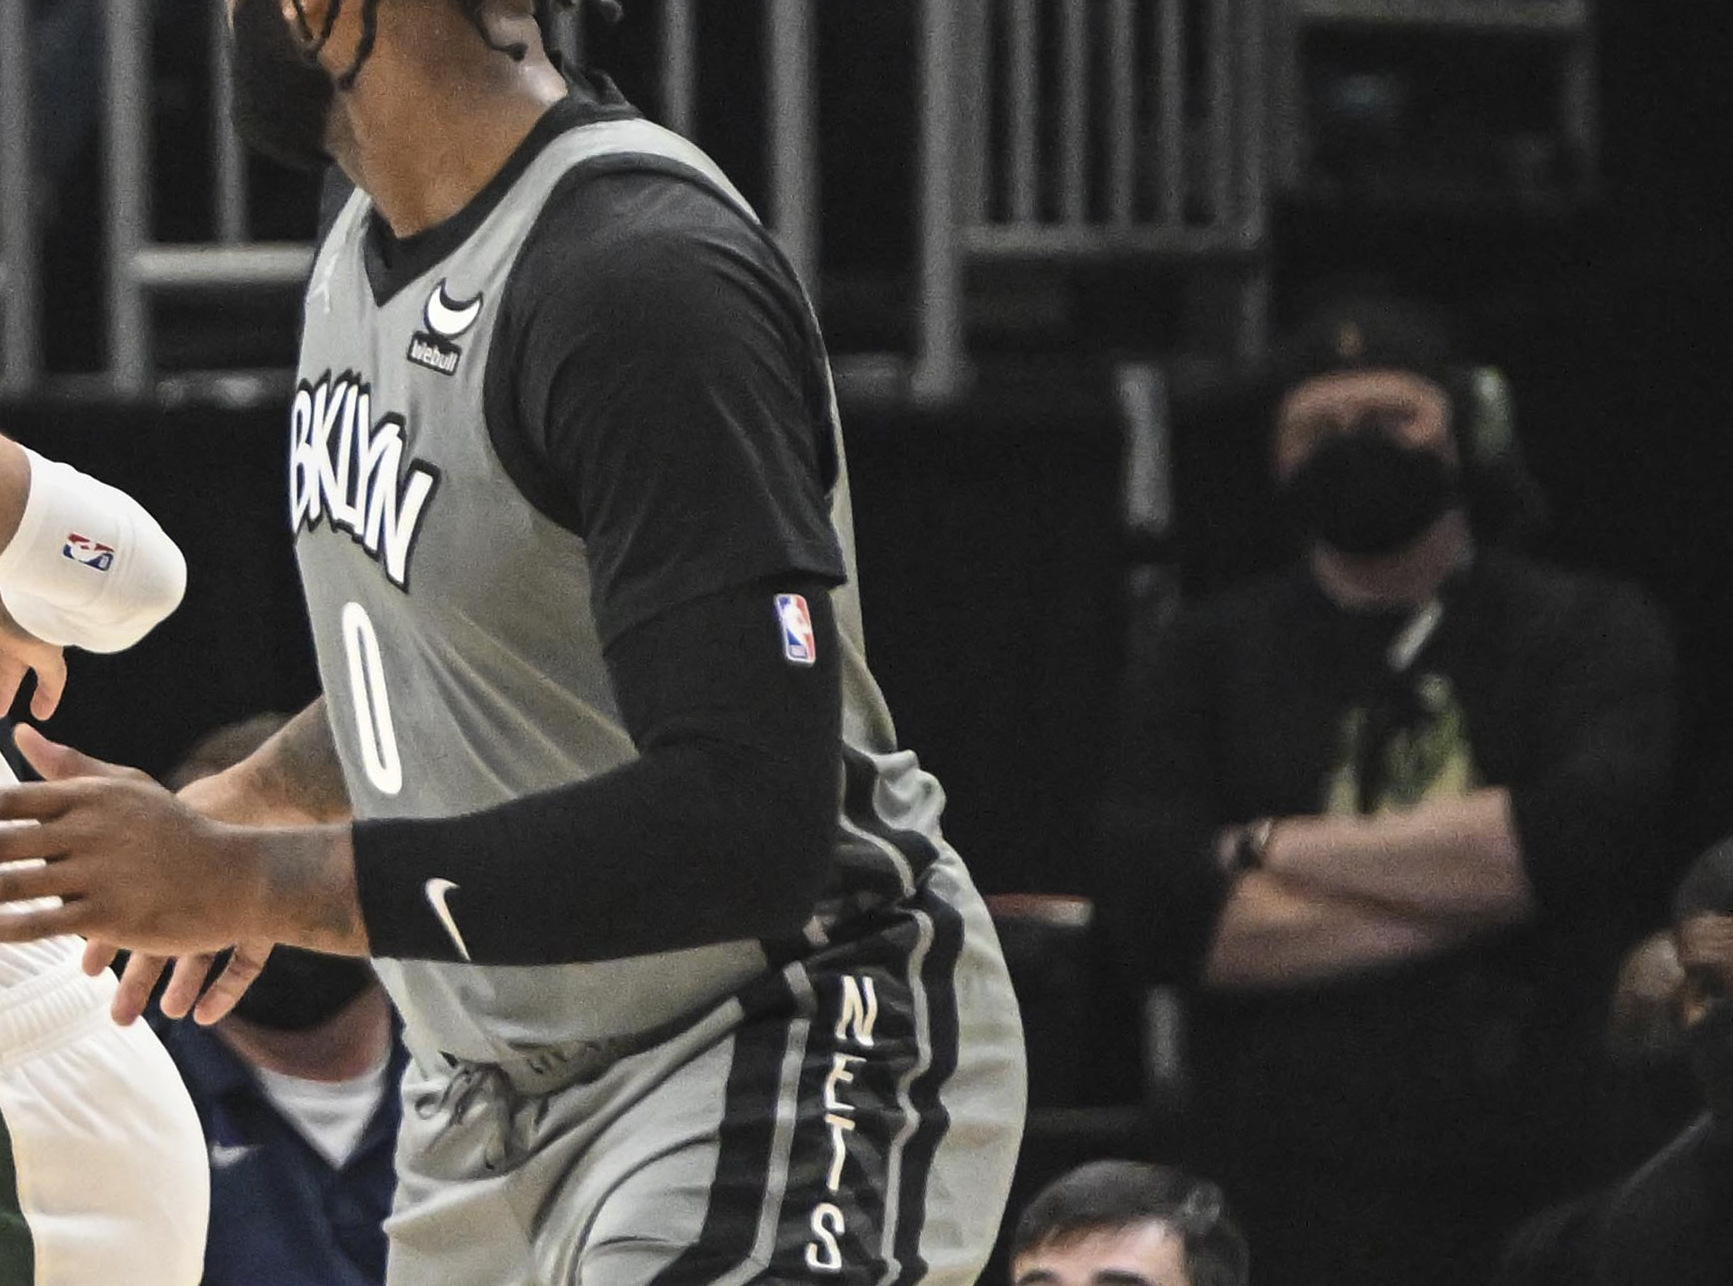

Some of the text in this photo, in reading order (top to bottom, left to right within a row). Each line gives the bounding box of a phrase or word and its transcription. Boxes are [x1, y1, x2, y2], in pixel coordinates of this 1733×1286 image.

[410, 337, 459, 373] Webull
[289, 378, 436, 586] BKLYN
[341, 601, 403, 795] 0
[805, 974, 879, 1274] NETS
